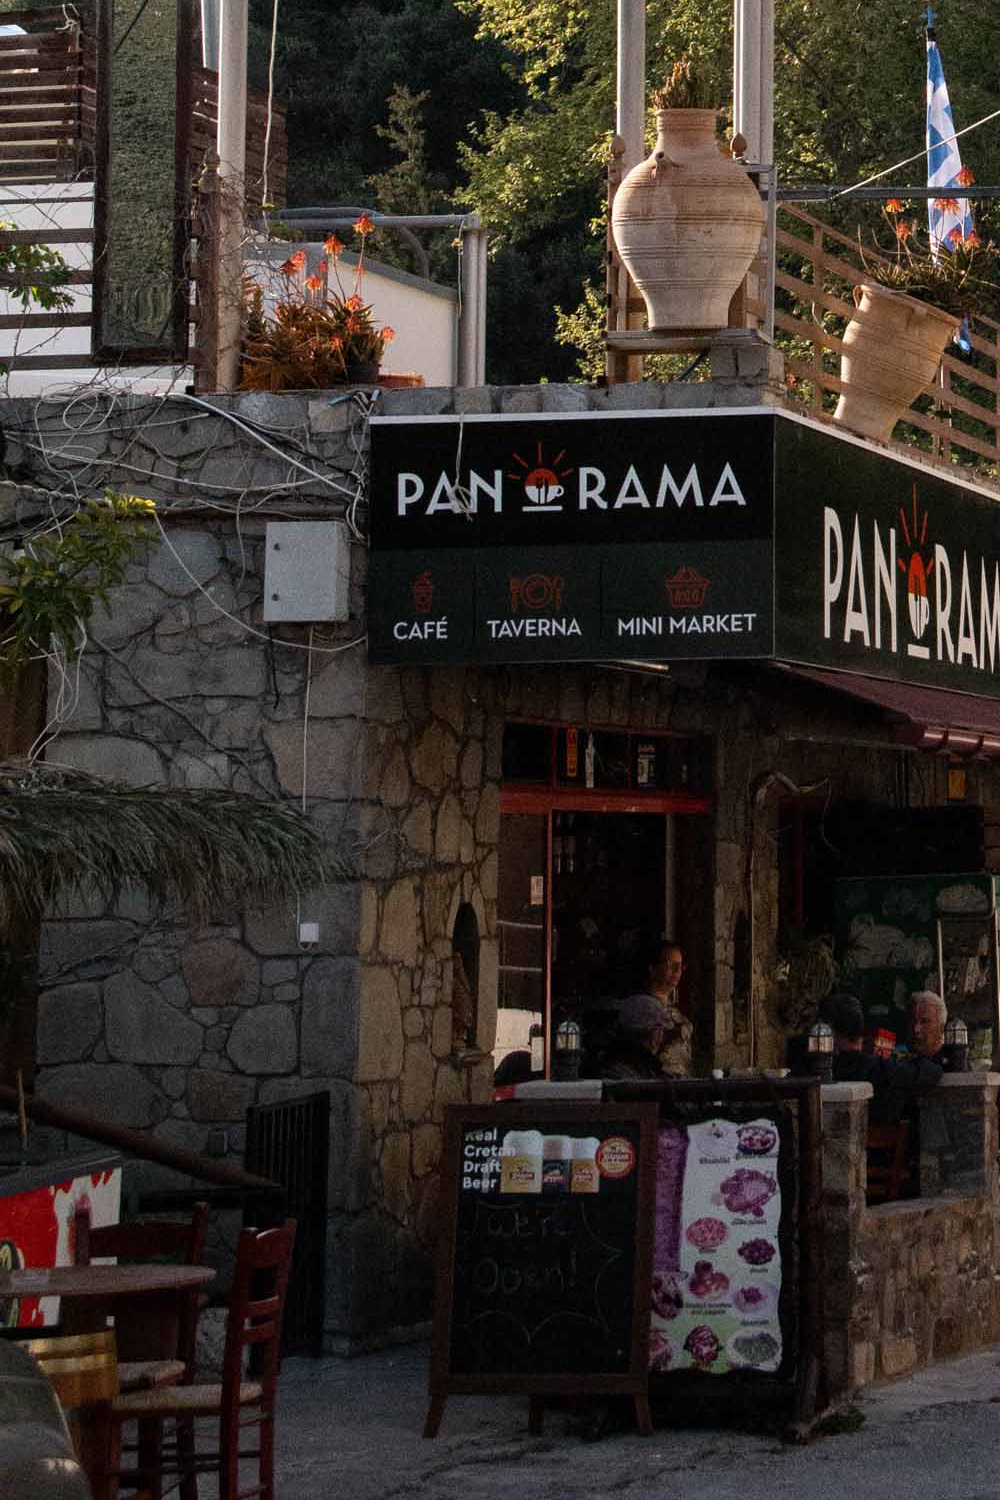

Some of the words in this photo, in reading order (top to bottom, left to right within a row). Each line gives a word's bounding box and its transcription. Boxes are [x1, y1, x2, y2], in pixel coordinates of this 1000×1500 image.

[393, 616, 448, 640] CAFÉ
[487, 617, 582, 638] TAVERNA
[618, 616, 662, 636] MINI
[669, 613, 757, 634] MARKET
[464, 1159, 502, 1173] Draft
[463, 1176, 497, 1189] Beer
